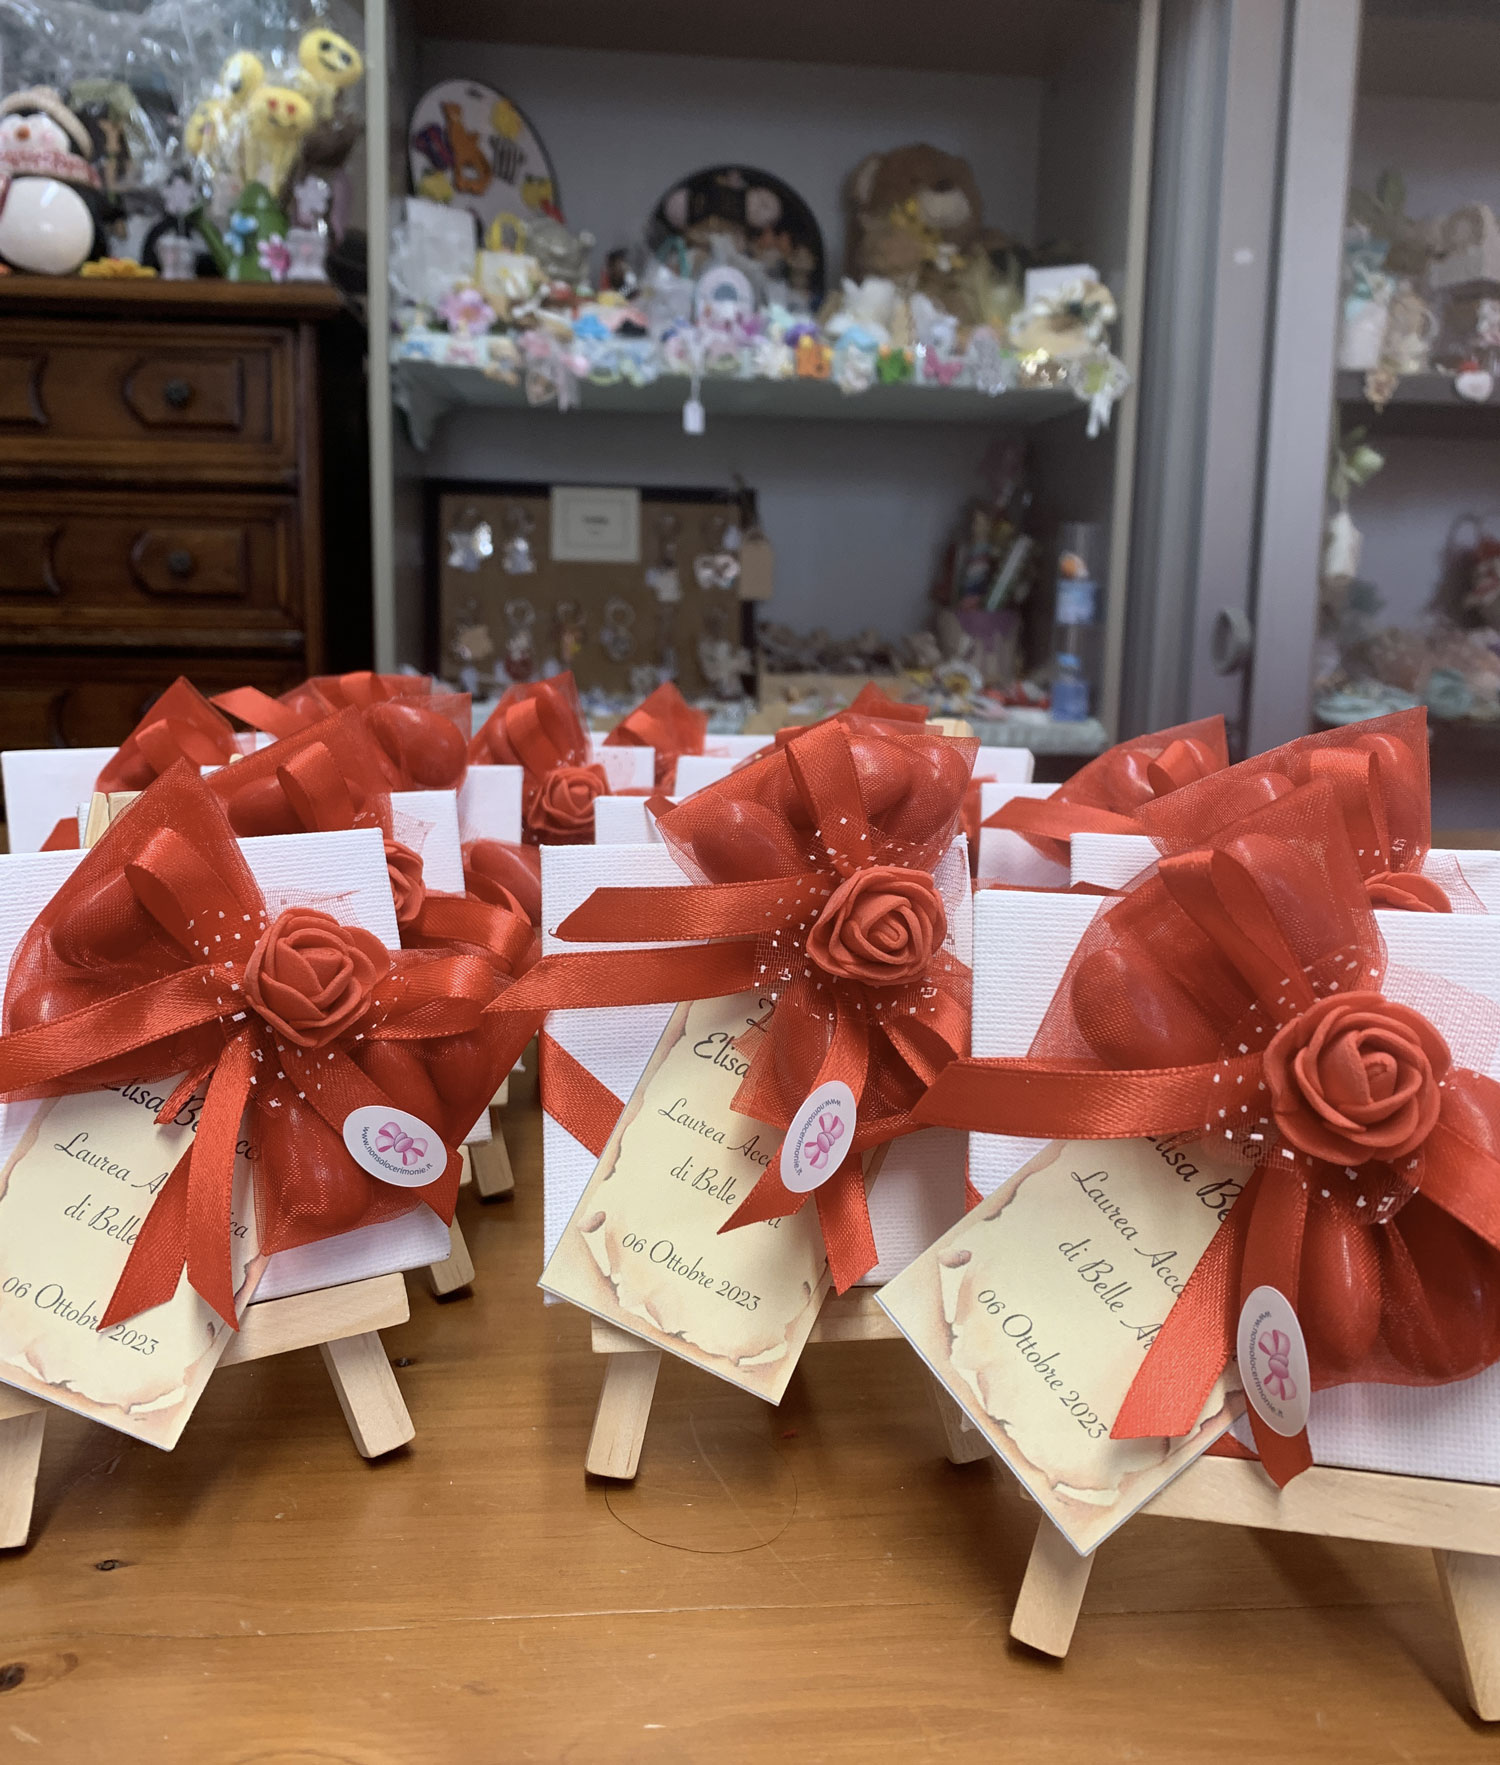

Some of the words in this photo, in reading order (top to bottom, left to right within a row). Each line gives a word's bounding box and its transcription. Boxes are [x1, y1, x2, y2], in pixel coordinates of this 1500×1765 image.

[53, 1131, 132, 1182] Laurea
[361, 1126, 433, 1176] www.nonsolocerimonie.it
[657, 1097, 725, 1145] Laurea
[792, 1098, 841, 1176] www.nonsolocerimonie.it
[668, 1155, 695, 1182] di
[691, 1166, 737, 1206] Belle
[1070, 1170, 1139, 1242] Laurea
[63, 1193, 93, 1221] di
[87, 1205, 142, 1246] Belle
[621, 1232, 648, 1254] 06
[648, 1239, 715, 1291] Ottobre
[715, 1280, 762, 1312] 2023
[1057, 1238, 1092, 1263] di
[1077, 1258, 1133, 1314] Belle
[2, 1276, 33, 1298] 06
[34, 1283, 104, 1333] Ottobr
[108, 1323, 160, 1356] 2023
[976, 1288, 1006, 1316] 06
[1002, 1312, 1062, 1392] Ottobre
[1058, 1389, 1109, 1440] 2023
[1248, 1310, 1285, 1419] www.nonsolocerimonie.it
